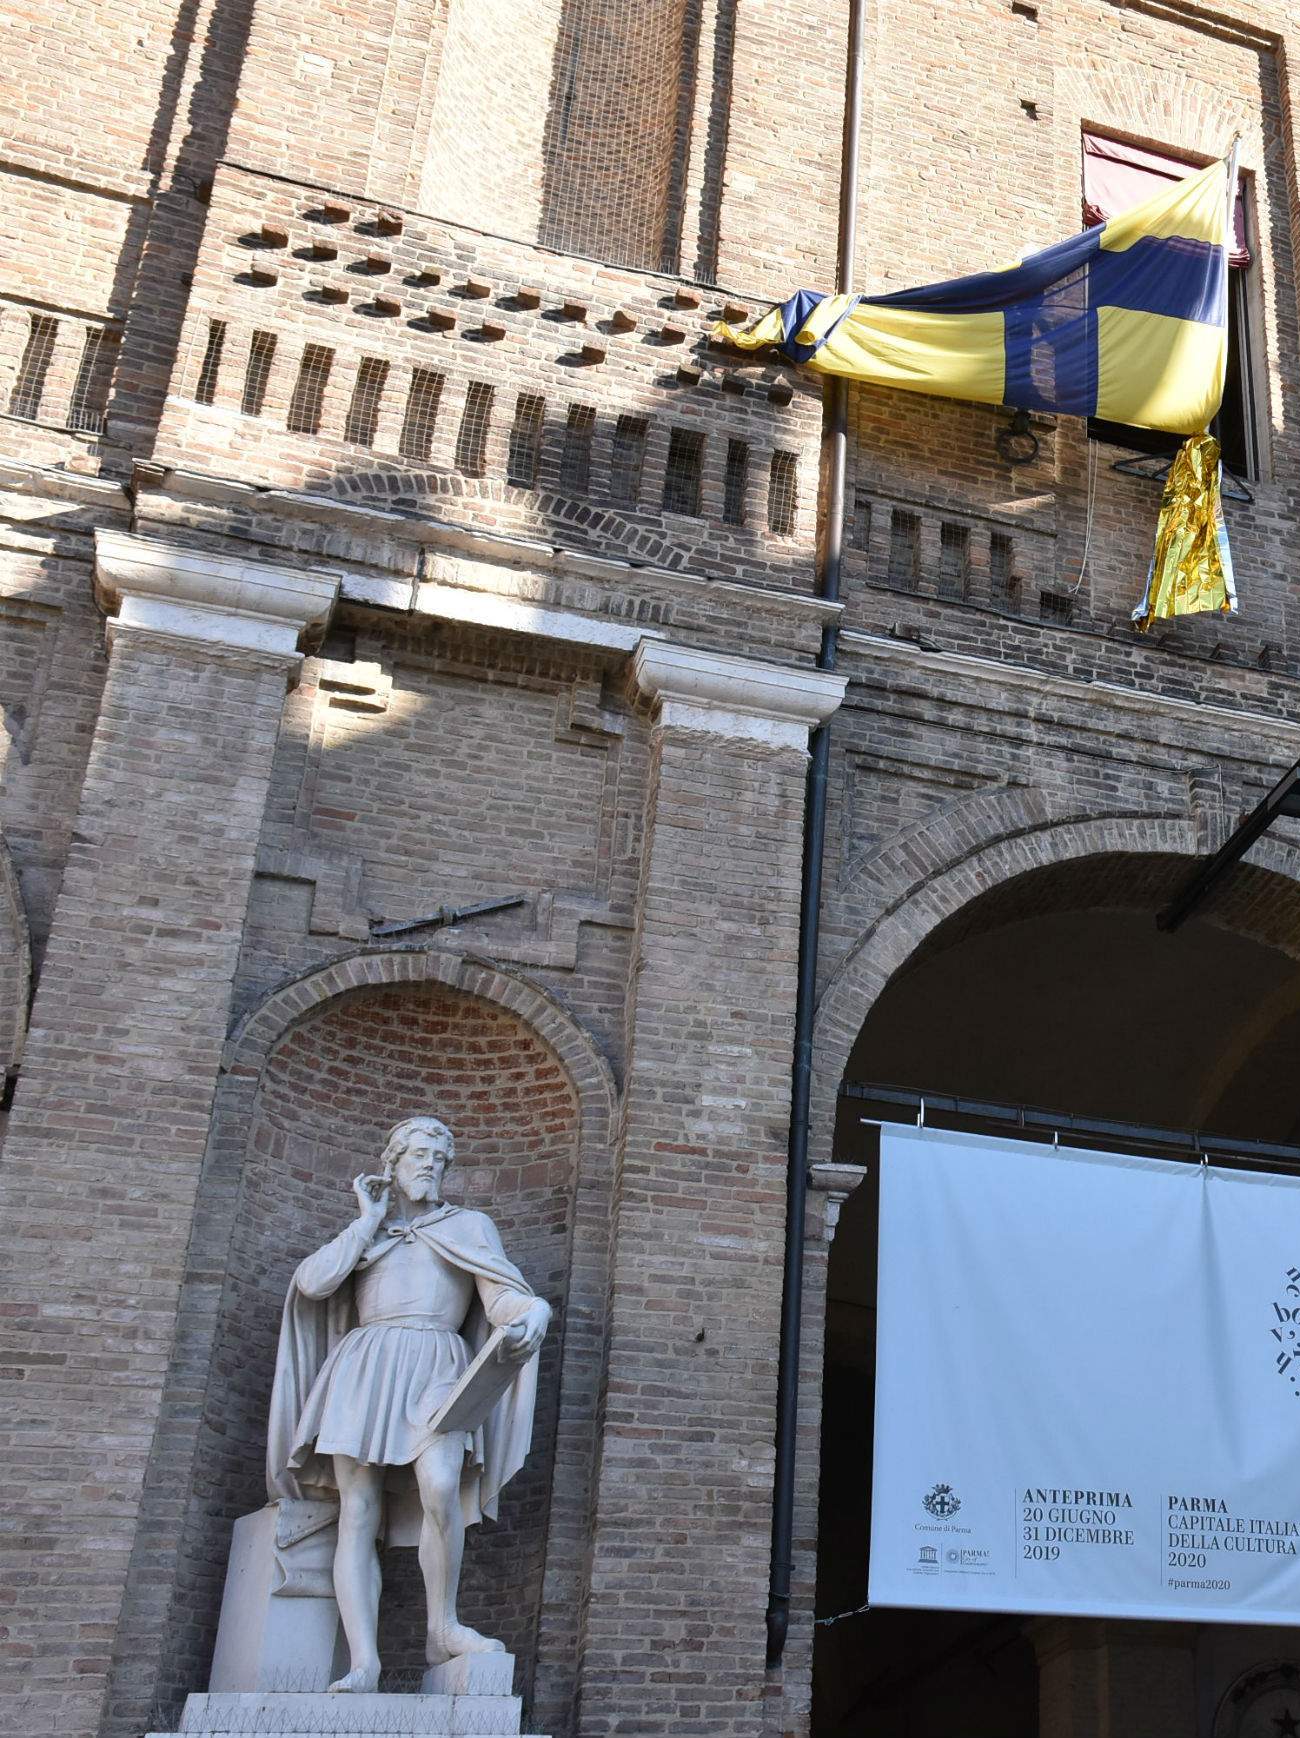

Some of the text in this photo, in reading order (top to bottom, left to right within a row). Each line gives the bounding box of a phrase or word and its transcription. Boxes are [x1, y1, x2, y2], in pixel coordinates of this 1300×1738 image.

[1022, 1488, 1133, 1508] ANTEPRIMA
[1168, 1495, 1228, 1513] PARMA
[1023, 1507, 1116, 1525] 20 GIUGNO
[1168, 1514, 1245, 1533] CAPITALE
[1023, 1526, 1135, 1545] 31 DICEMBRE
[1168, 1532, 1297, 1555] DELLA CULTURA
[1023, 1544, 1060, 1560] 2019
[1168, 1552, 1206, 1568] 2020
[1168, 1578, 1231, 1590] #parma2020
